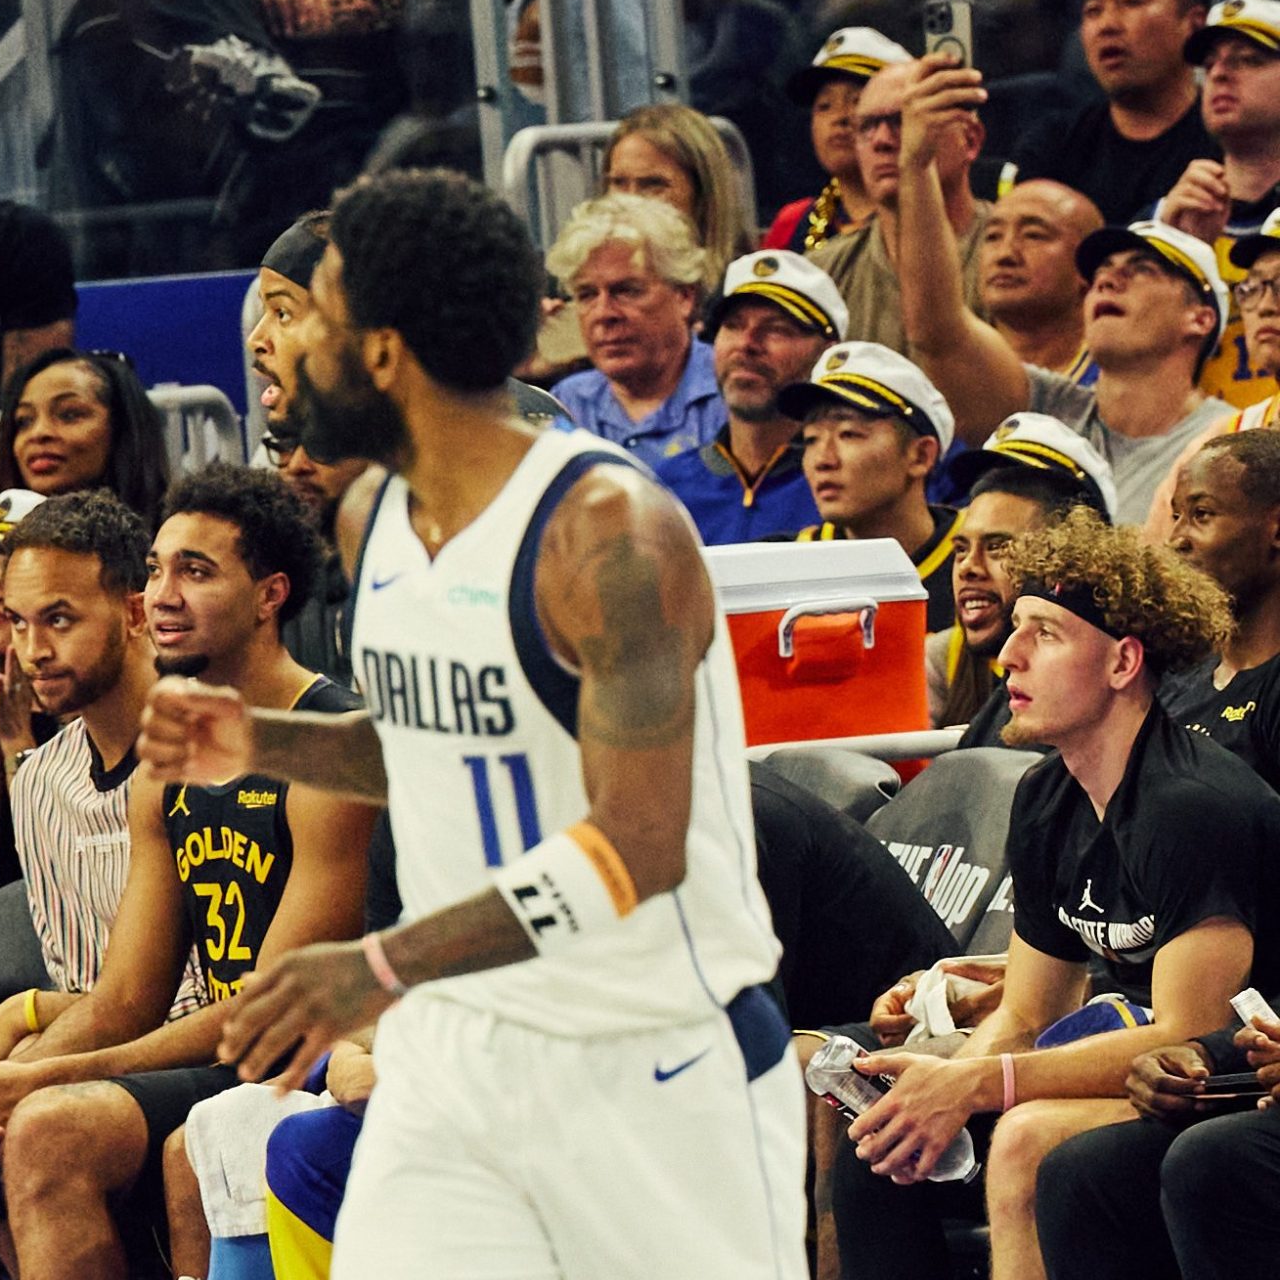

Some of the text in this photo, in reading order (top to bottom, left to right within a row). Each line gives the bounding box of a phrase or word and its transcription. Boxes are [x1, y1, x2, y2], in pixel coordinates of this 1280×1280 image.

[361, 647, 519, 737] DALLAS
[462, 752, 544, 869] 11
[176, 826, 275, 885] GOLDEN
[192, 881, 252, 961] 32
